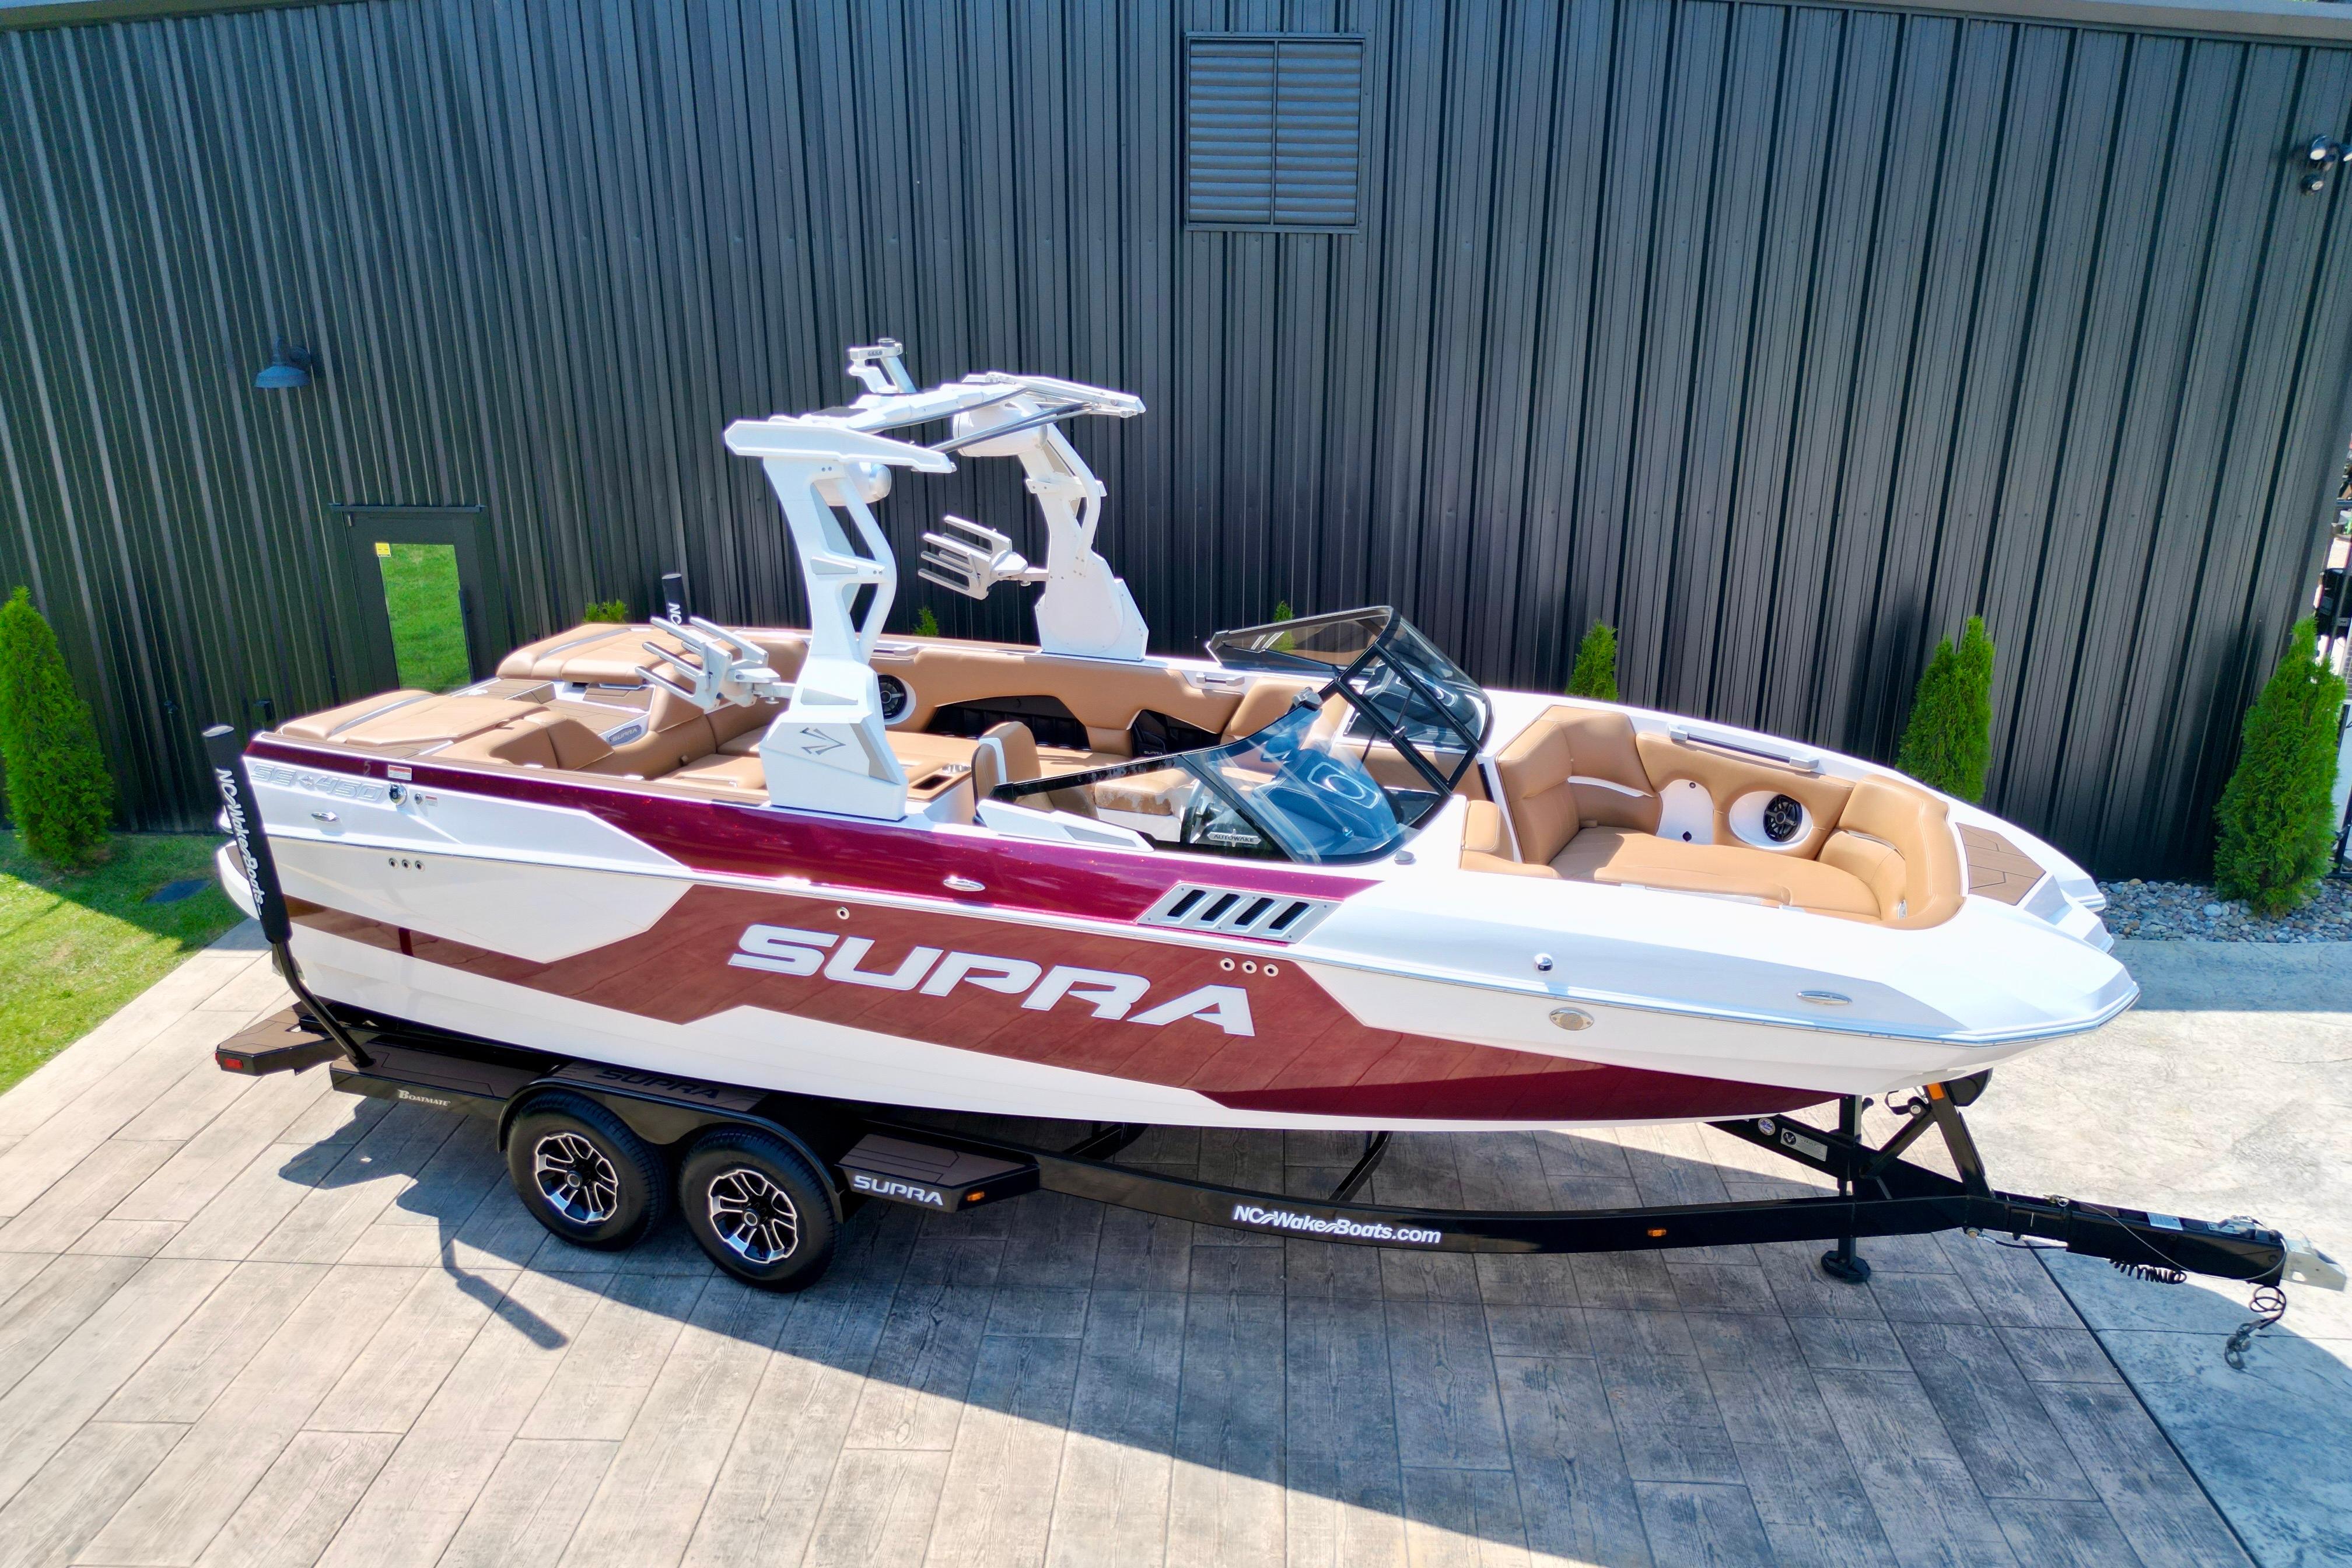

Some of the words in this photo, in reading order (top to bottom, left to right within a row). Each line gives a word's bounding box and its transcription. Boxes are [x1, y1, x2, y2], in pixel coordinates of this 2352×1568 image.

[612, 727, 638, 741] SUPRA
[251, 764, 296, 786] SE
[314, 775, 385, 802] 450
[1213, 834, 1254, 842] AUTOWAKE
[728, 923, 1255, 1037] SUPRA
[595, 1069, 720, 1099] SUPRA
[853, 1175, 943, 1206] SUPRA
